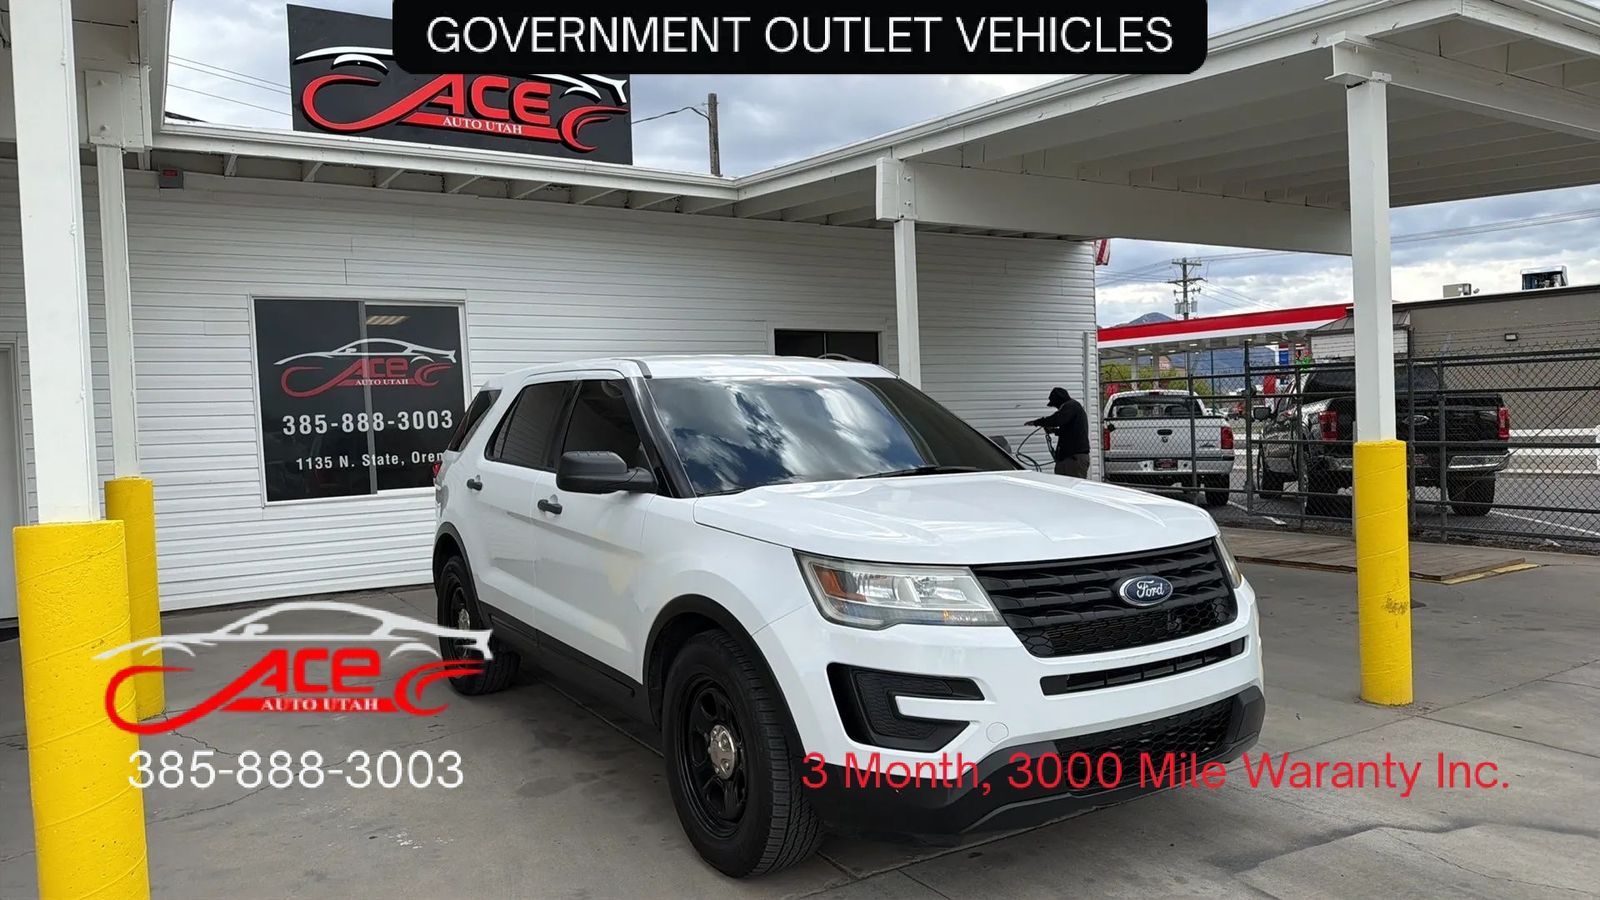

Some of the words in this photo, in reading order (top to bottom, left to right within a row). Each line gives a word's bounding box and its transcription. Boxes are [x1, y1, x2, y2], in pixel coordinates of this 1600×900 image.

[442, 116, 483, 130] AUTO
[485, 121, 523, 135] UTAH
[355, 378, 382, 387] AUTO
[382, 378, 409, 386] UTAH
[282, 409, 453, 436] 385-888-3003
[295, 456, 333, 471] 1135
[339, 454, 355, 468] N.
[361, 453, 405, 467] State,
[1136, 580, 1165, 598] Ford
